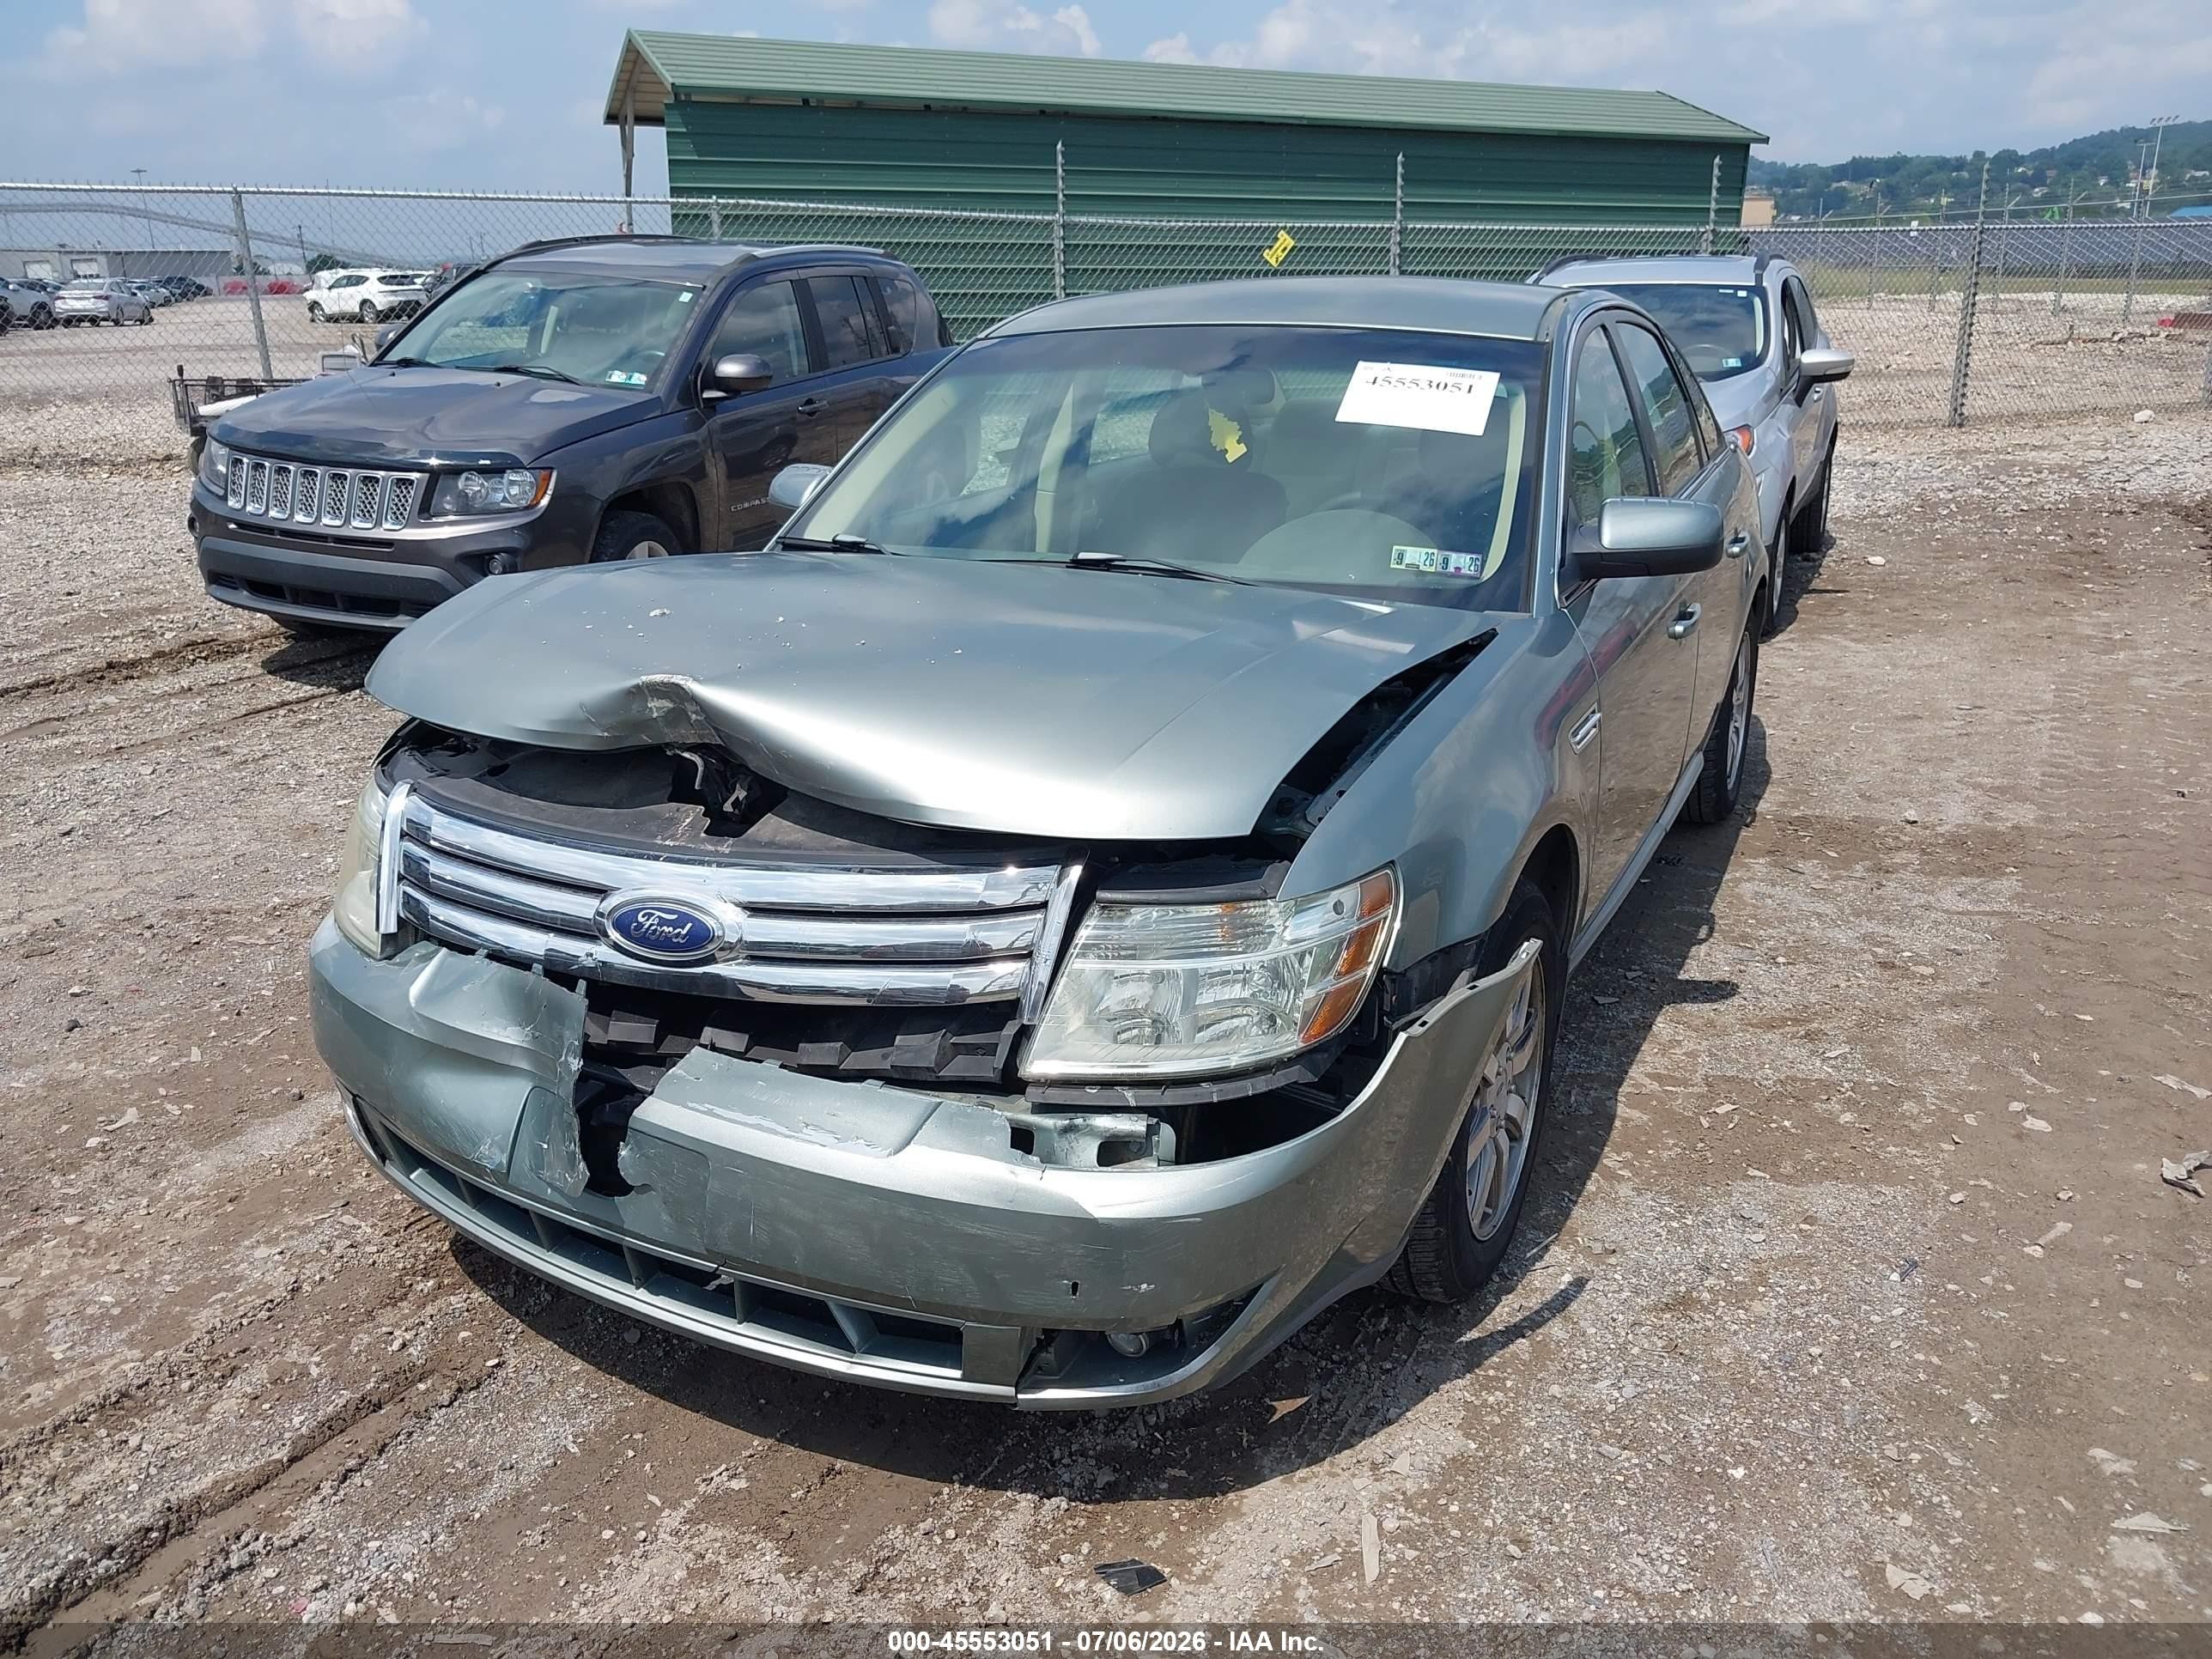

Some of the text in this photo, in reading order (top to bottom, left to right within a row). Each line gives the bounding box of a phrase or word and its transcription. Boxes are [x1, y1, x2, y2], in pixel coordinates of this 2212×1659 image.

[1424, 551, 1435, 568] 26
[1468, 556, 1480, 573] 26
[630, 908, 693, 944] Ford
